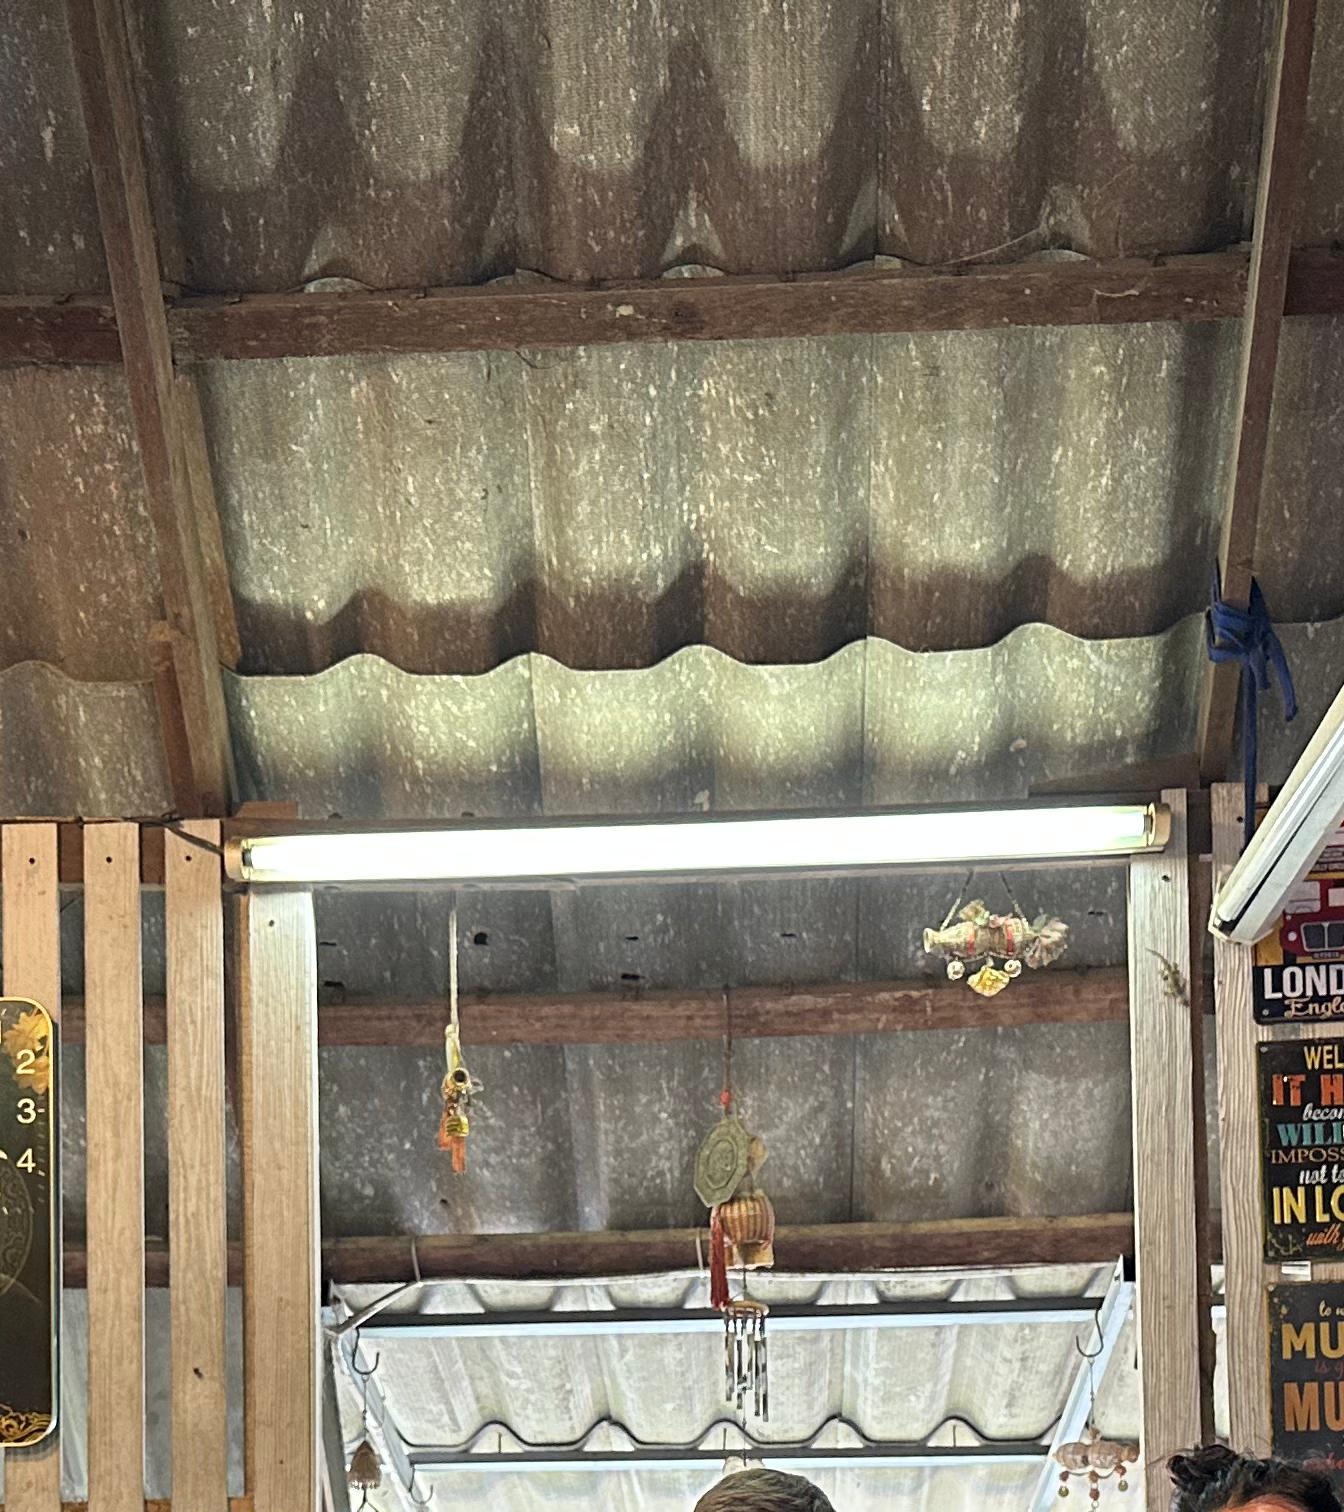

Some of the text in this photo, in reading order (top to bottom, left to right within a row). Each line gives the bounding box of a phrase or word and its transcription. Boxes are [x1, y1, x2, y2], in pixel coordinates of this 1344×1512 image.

[16, 1049, 36, 1075] 2
[1272, 1073, 1305, 1106] IT
[16, 1098, 37, 1124] 3
[16, 1148, 36, 1174] 4
[1299, 1164, 1328, 1184] not
[1272, 1186, 1305, 1224] IN
[1306, 1224, 1339, 1246] with
[1319, 1300, 1331, 1317] to
